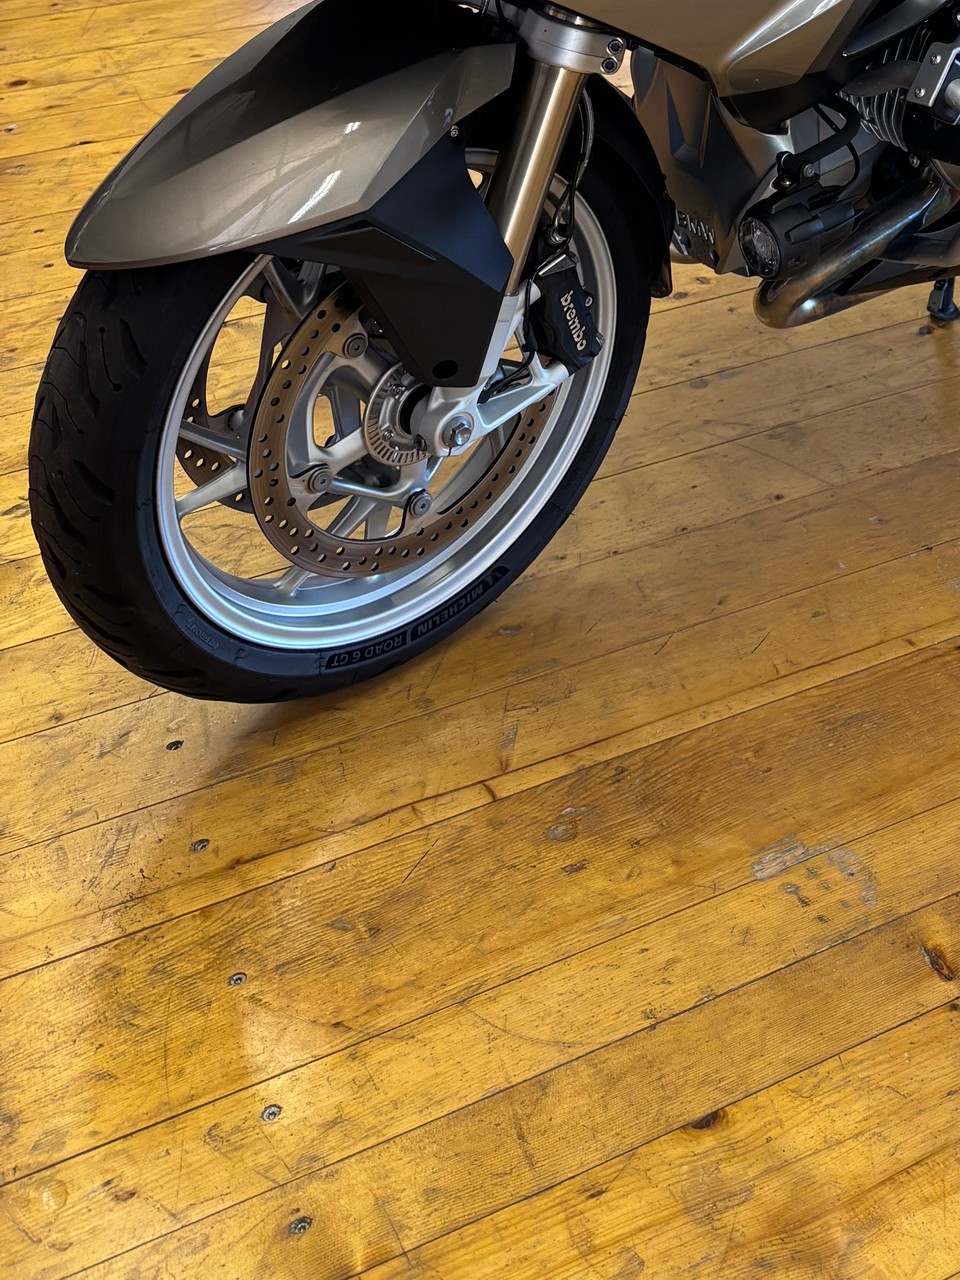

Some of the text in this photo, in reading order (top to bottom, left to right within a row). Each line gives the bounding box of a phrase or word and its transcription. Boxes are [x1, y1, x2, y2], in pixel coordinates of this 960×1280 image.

[560, 289, 587, 351] brembo
[331, 583, 485, 667] MICHELIN ROAD 6 GT
